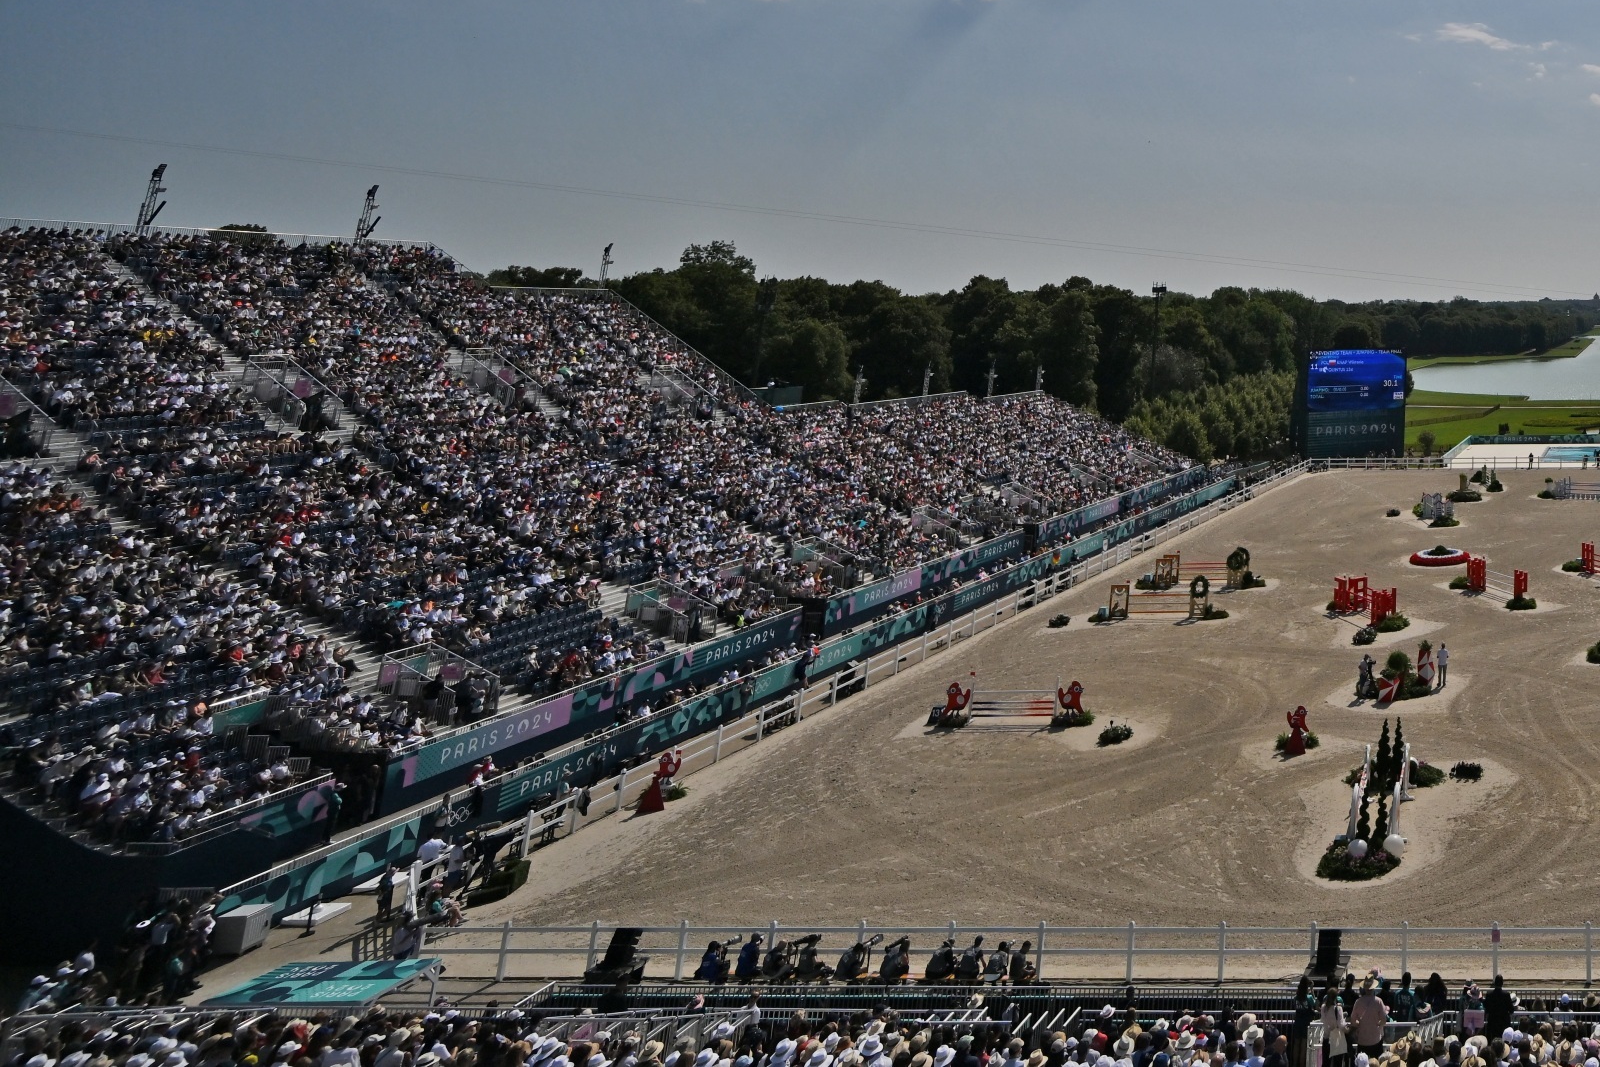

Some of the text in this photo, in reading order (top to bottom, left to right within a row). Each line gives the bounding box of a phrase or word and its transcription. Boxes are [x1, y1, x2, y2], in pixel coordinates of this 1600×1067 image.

[745, 628, 776, 650] 2024
[932, 708, 940, 717] 13
[505, 711, 552, 740] 2024
